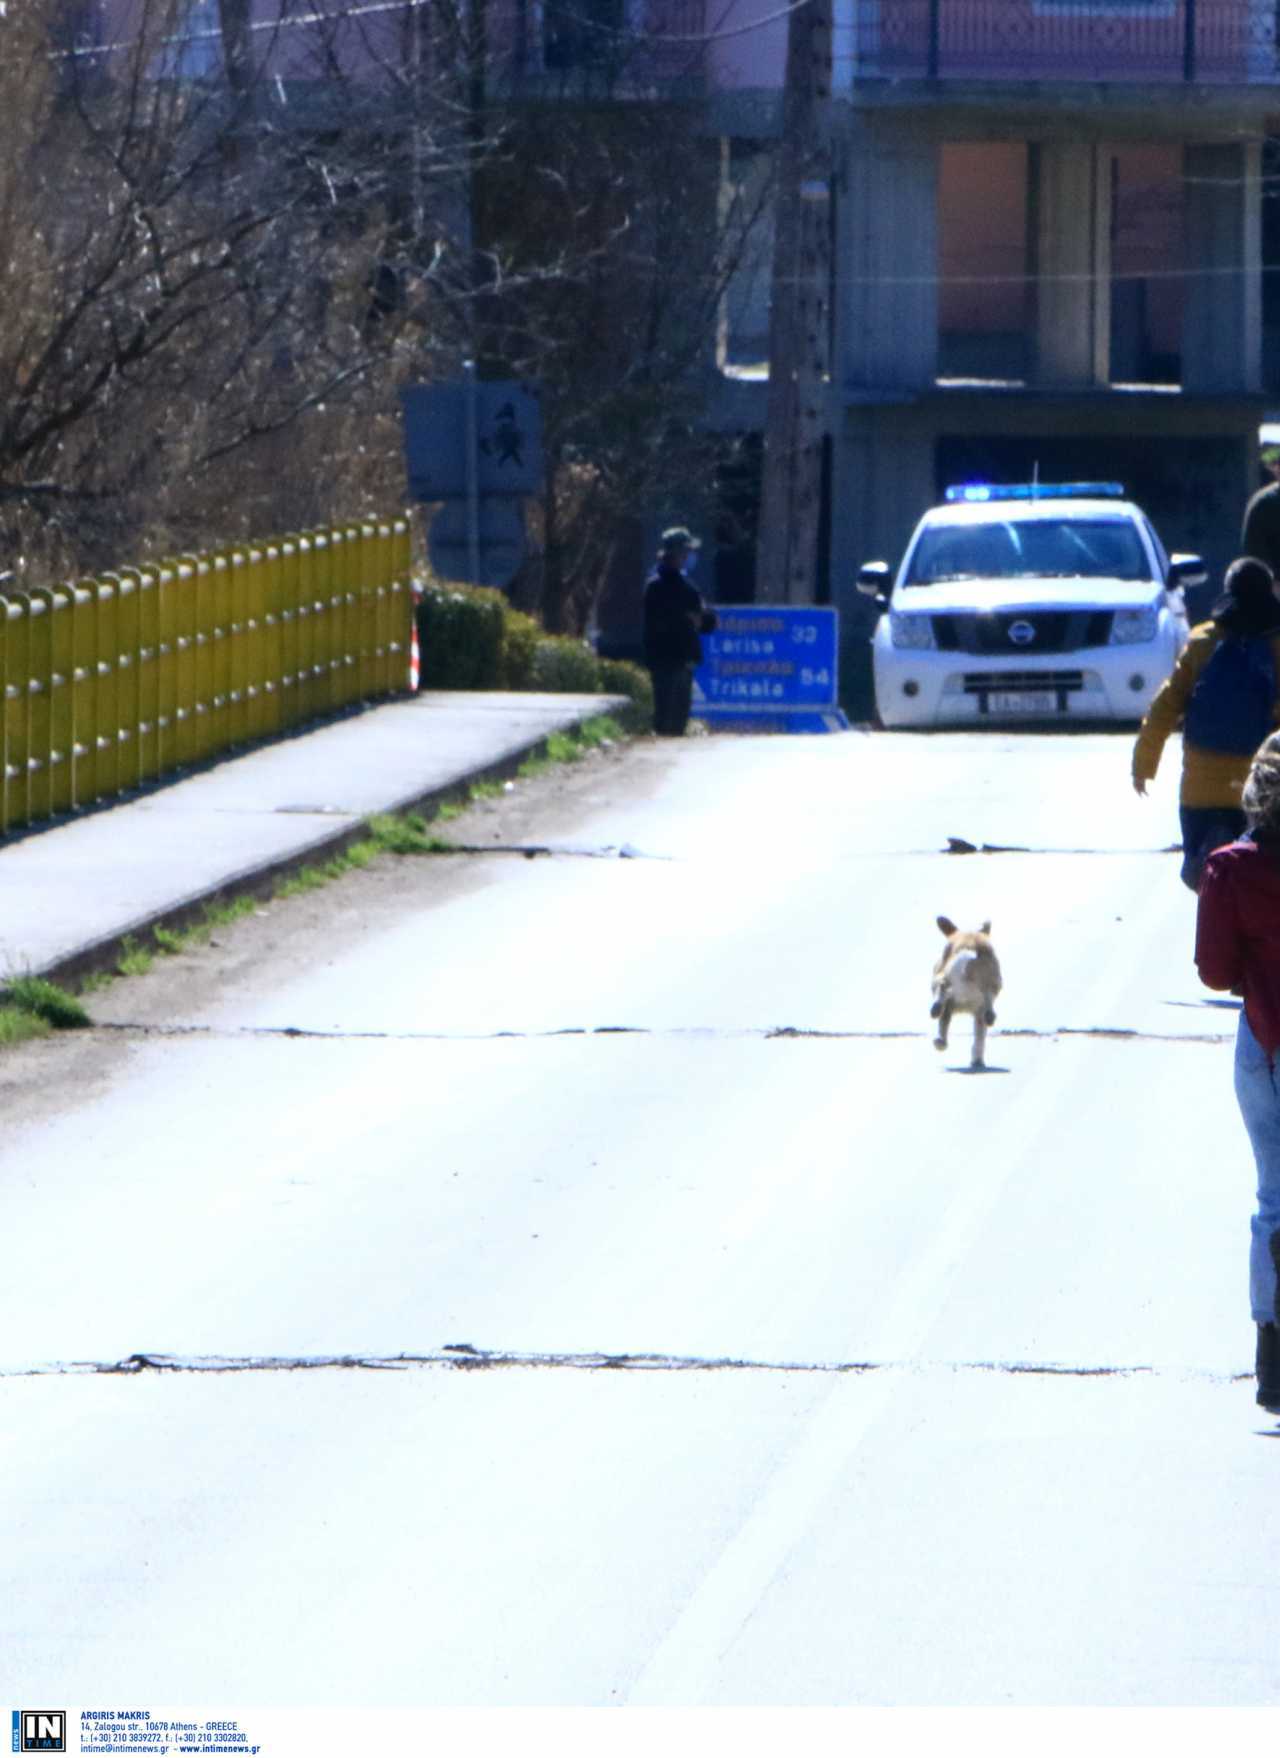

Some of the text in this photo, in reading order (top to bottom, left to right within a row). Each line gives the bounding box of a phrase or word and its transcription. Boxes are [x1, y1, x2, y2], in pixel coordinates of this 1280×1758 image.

[709, 635, 775, 654] Larisa
[800, 667, 830, 686] 54
[709, 678, 784, 697] Trikala
